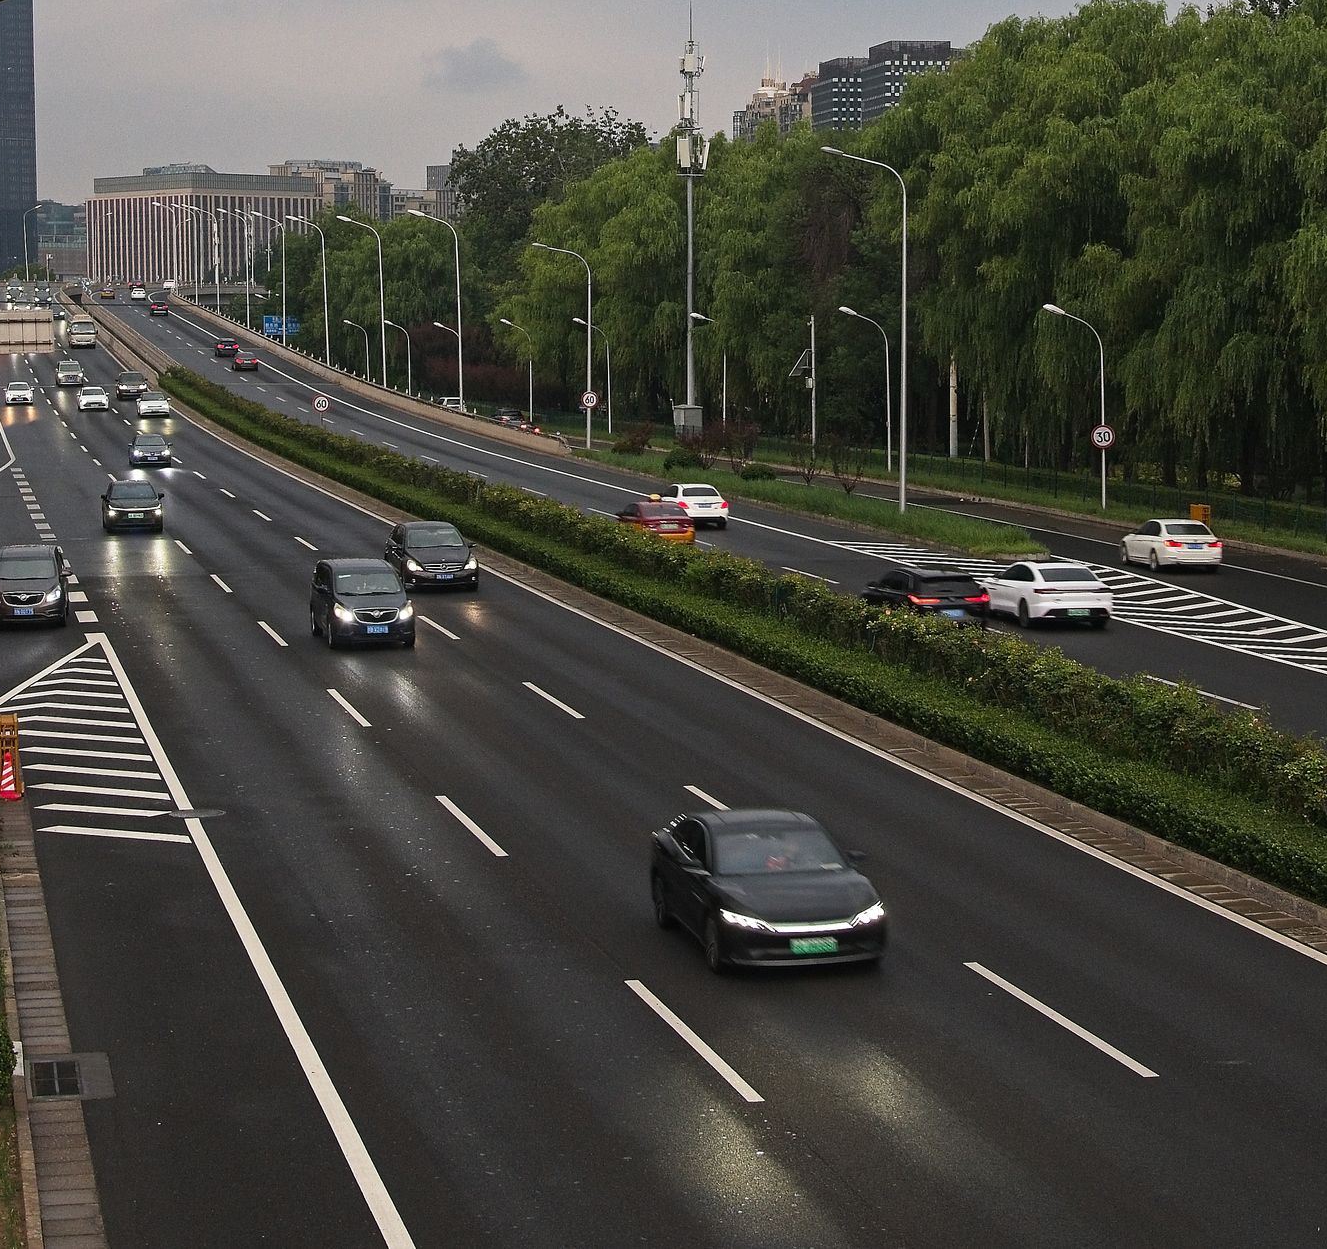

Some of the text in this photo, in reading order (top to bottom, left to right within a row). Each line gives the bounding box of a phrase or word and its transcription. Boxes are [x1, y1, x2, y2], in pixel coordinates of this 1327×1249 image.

[317, 399, 327, 409] 60
[585, 396, 594, 404] 60
[1096, 431, 1110, 443] 30
